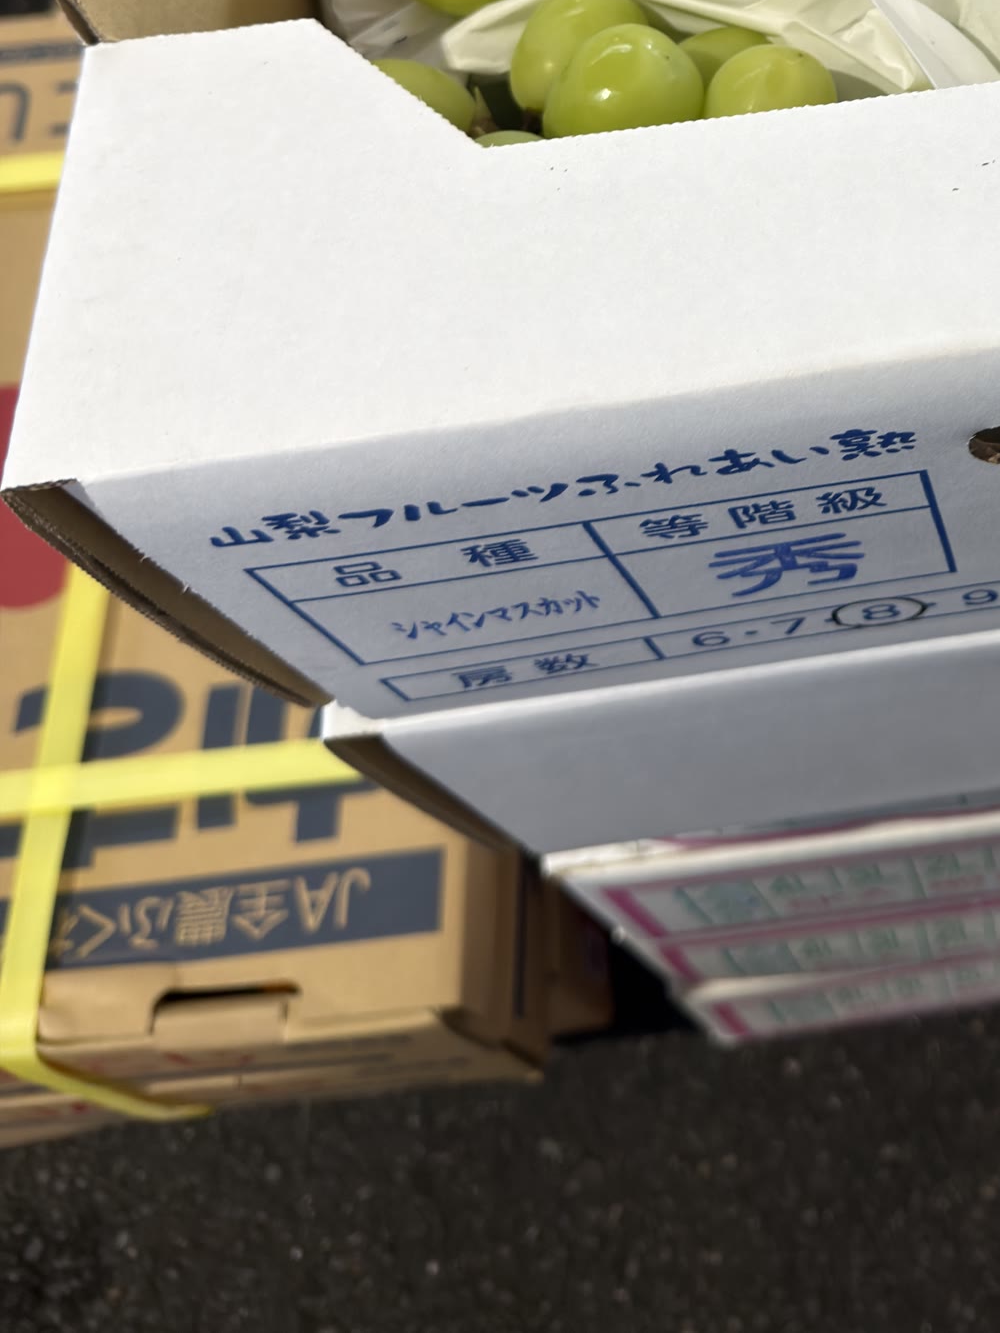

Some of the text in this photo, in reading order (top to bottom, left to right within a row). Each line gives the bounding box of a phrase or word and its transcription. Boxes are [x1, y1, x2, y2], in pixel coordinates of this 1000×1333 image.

[639, 486, 888, 539] 等階級
[332, 538, 539, 588] 品種
[707, 532, 866, 598] 秀
[391, 590, 600, 639] シャインマスカット
[455, 653, 598, 689] 房数
